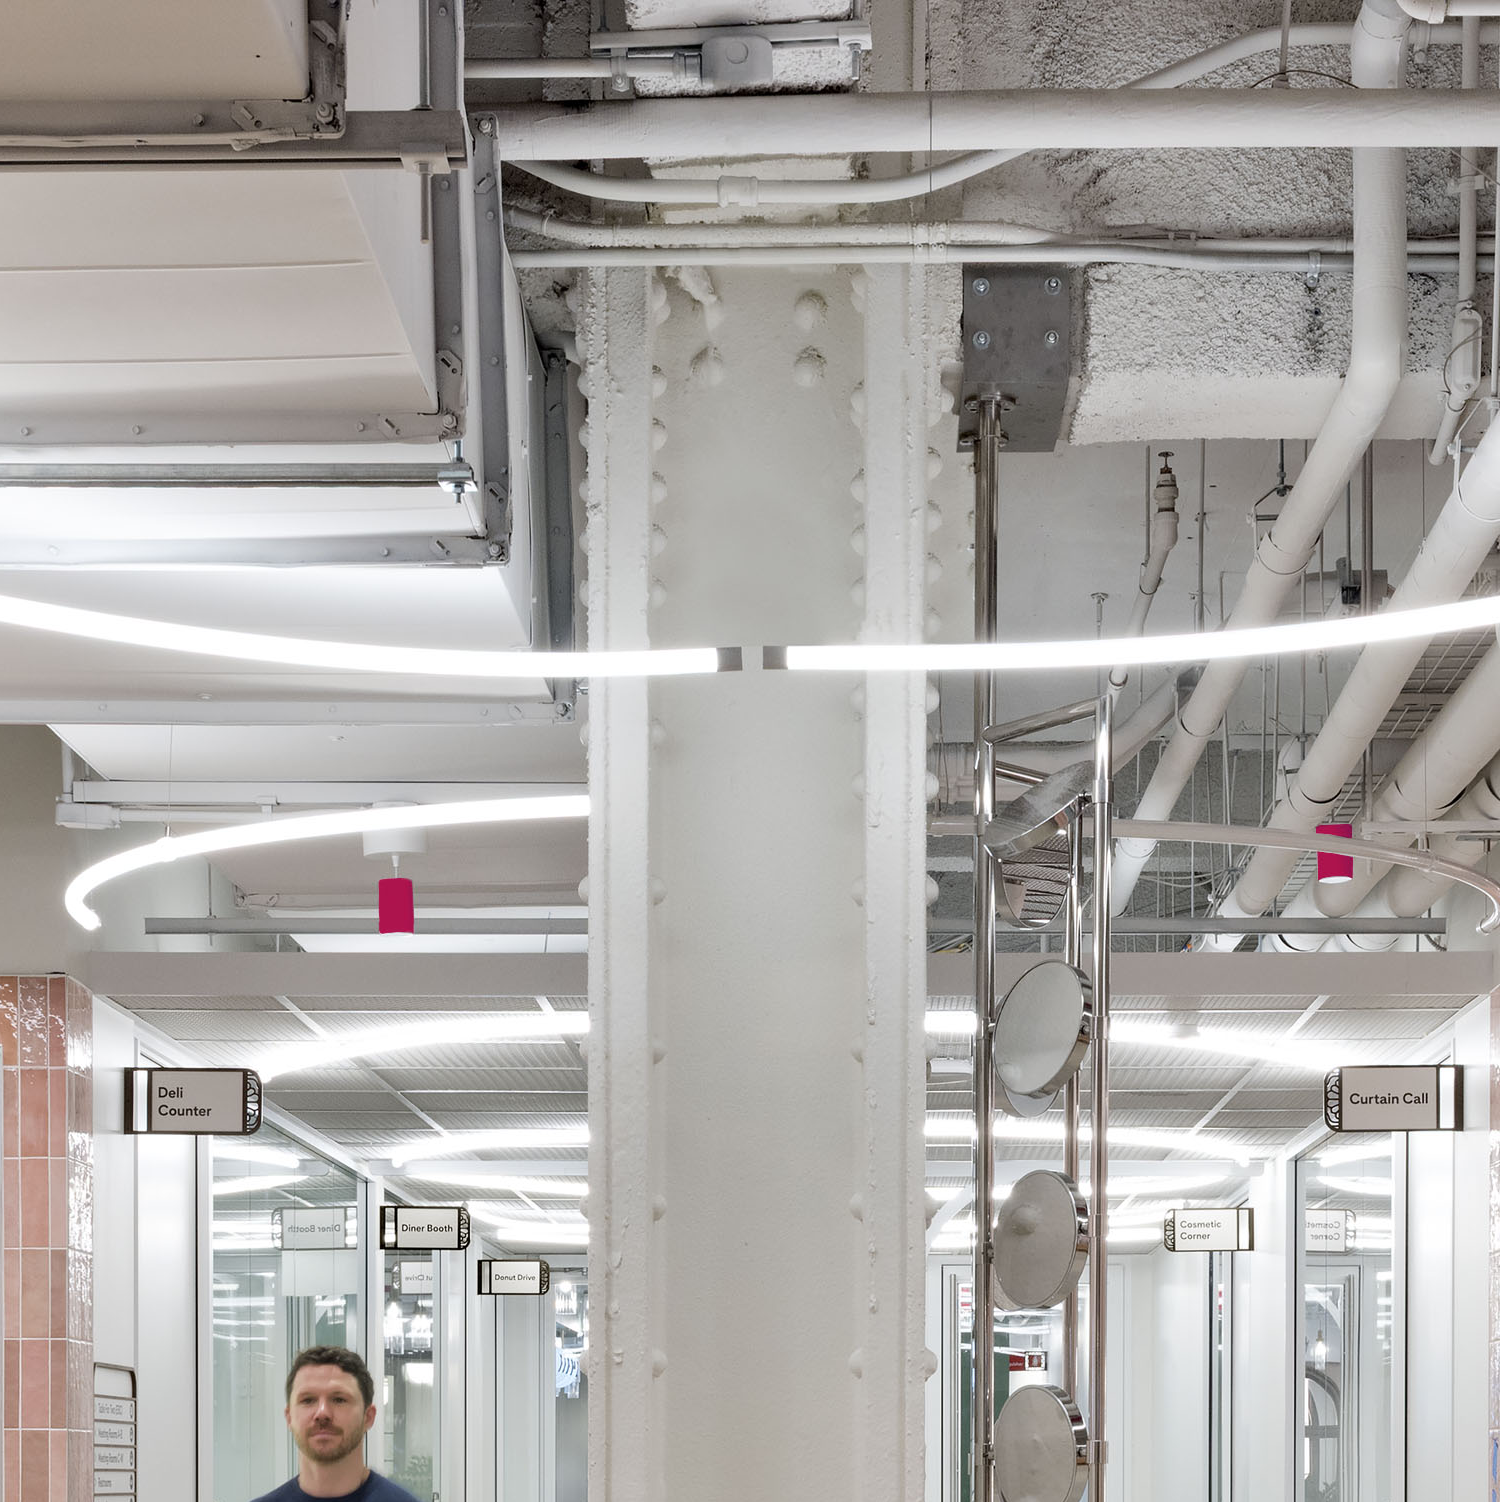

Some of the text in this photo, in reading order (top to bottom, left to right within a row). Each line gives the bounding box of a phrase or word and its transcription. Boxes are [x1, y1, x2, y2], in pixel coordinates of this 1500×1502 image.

[158, 1086, 184, 1098] Deli
[1349, 1092, 1429, 1105] Curtain Call
[158, 1104, 212, 1117] Counter
[401, 1224, 453, 1233] Diner Booth
[1179, 1220, 1222, 1229] Cosmetic
[1179, 1232, 1211, 1240] Corner
